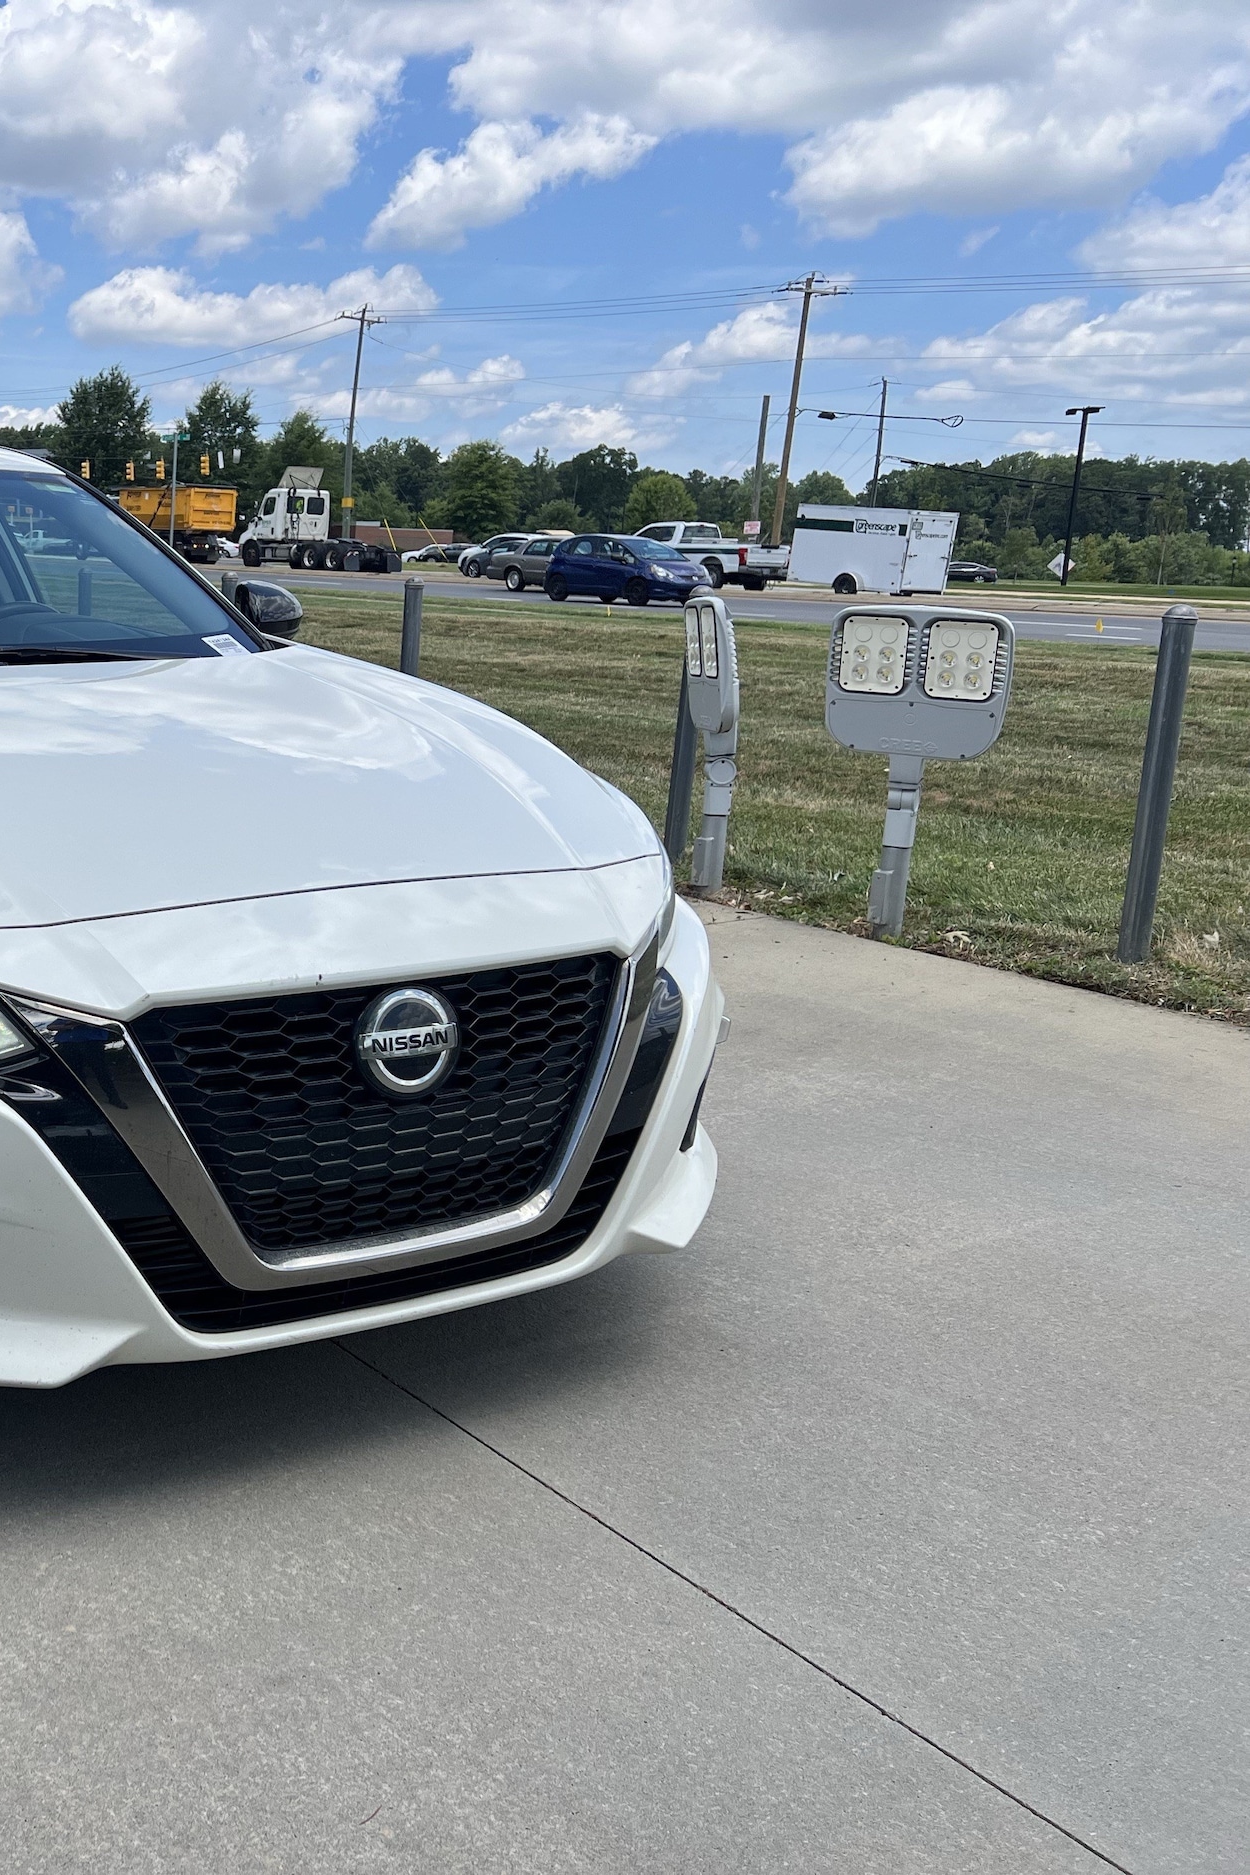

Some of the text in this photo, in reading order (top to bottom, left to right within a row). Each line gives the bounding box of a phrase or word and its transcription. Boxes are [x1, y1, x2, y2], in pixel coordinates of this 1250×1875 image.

[856, 520, 897, 533] greenscape
[879, 736, 923, 752] CREE
[371, 1029, 449, 1053] NISSAN
